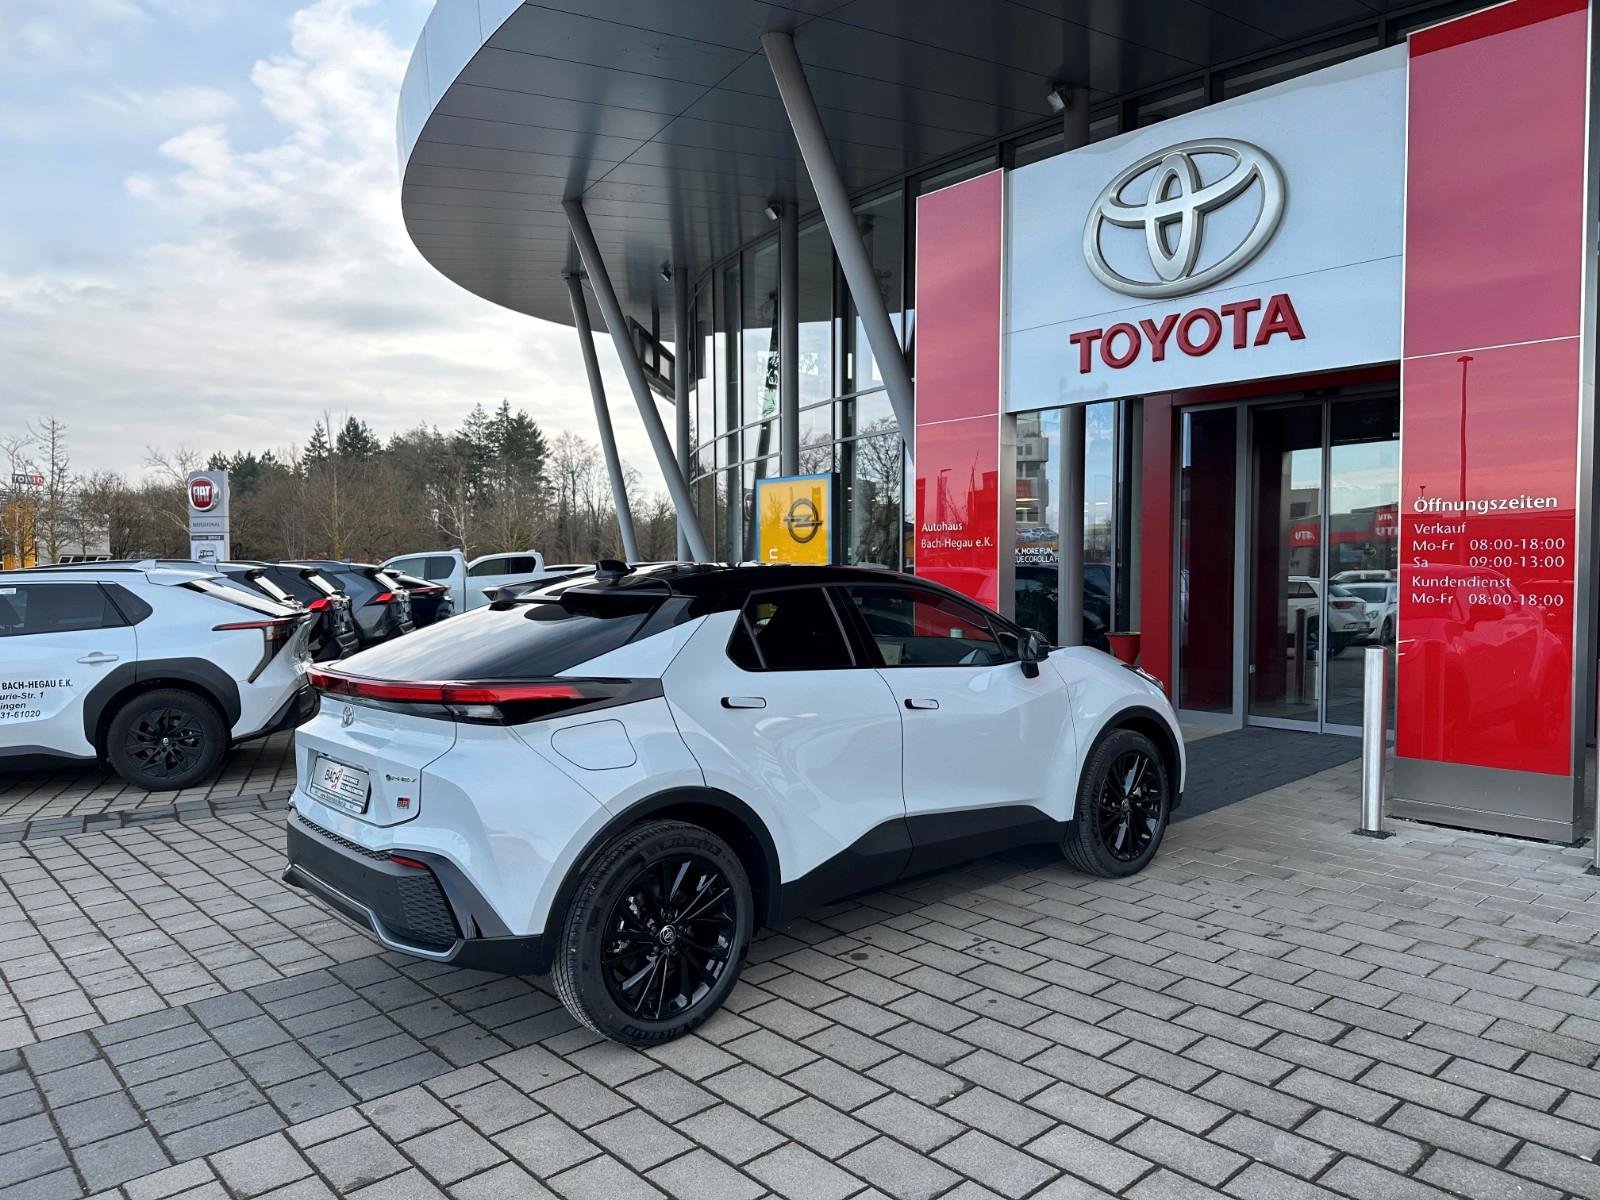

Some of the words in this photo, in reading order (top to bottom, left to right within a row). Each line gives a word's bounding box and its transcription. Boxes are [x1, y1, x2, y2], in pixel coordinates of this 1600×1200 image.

[1070, 293, 1306, 374] TOYOTA
[192, 486, 211, 502] FIAT
[1413, 495, 1557, 514] Öffnungszeiten
[921, 521, 963, 532] Autohaus
[1414, 522, 1466, 534] Verkauf
[921, 538, 973, 551] Bach-Hegau
[975, 537, 994, 547] e.K.
[1412, 540, 1454, 551] Mo-Fr
[1469, 537, 1565, 551] 08:00-18:00
[1413, 556, 1428, 568] Sa
[1469, 555, 1565, 568] 09:00-13:00
[1412, 575, 1511, 588] Kundendienst
[1412, 593, 1453, 604] Mo-Fr
[1468, 593, 1564, 607] 08:00-18:00
[2, 680, 56, 690] BACH-HEGAU
[58, 679, 73, 688] E.K.
[39, 691, 44, 699] 1
